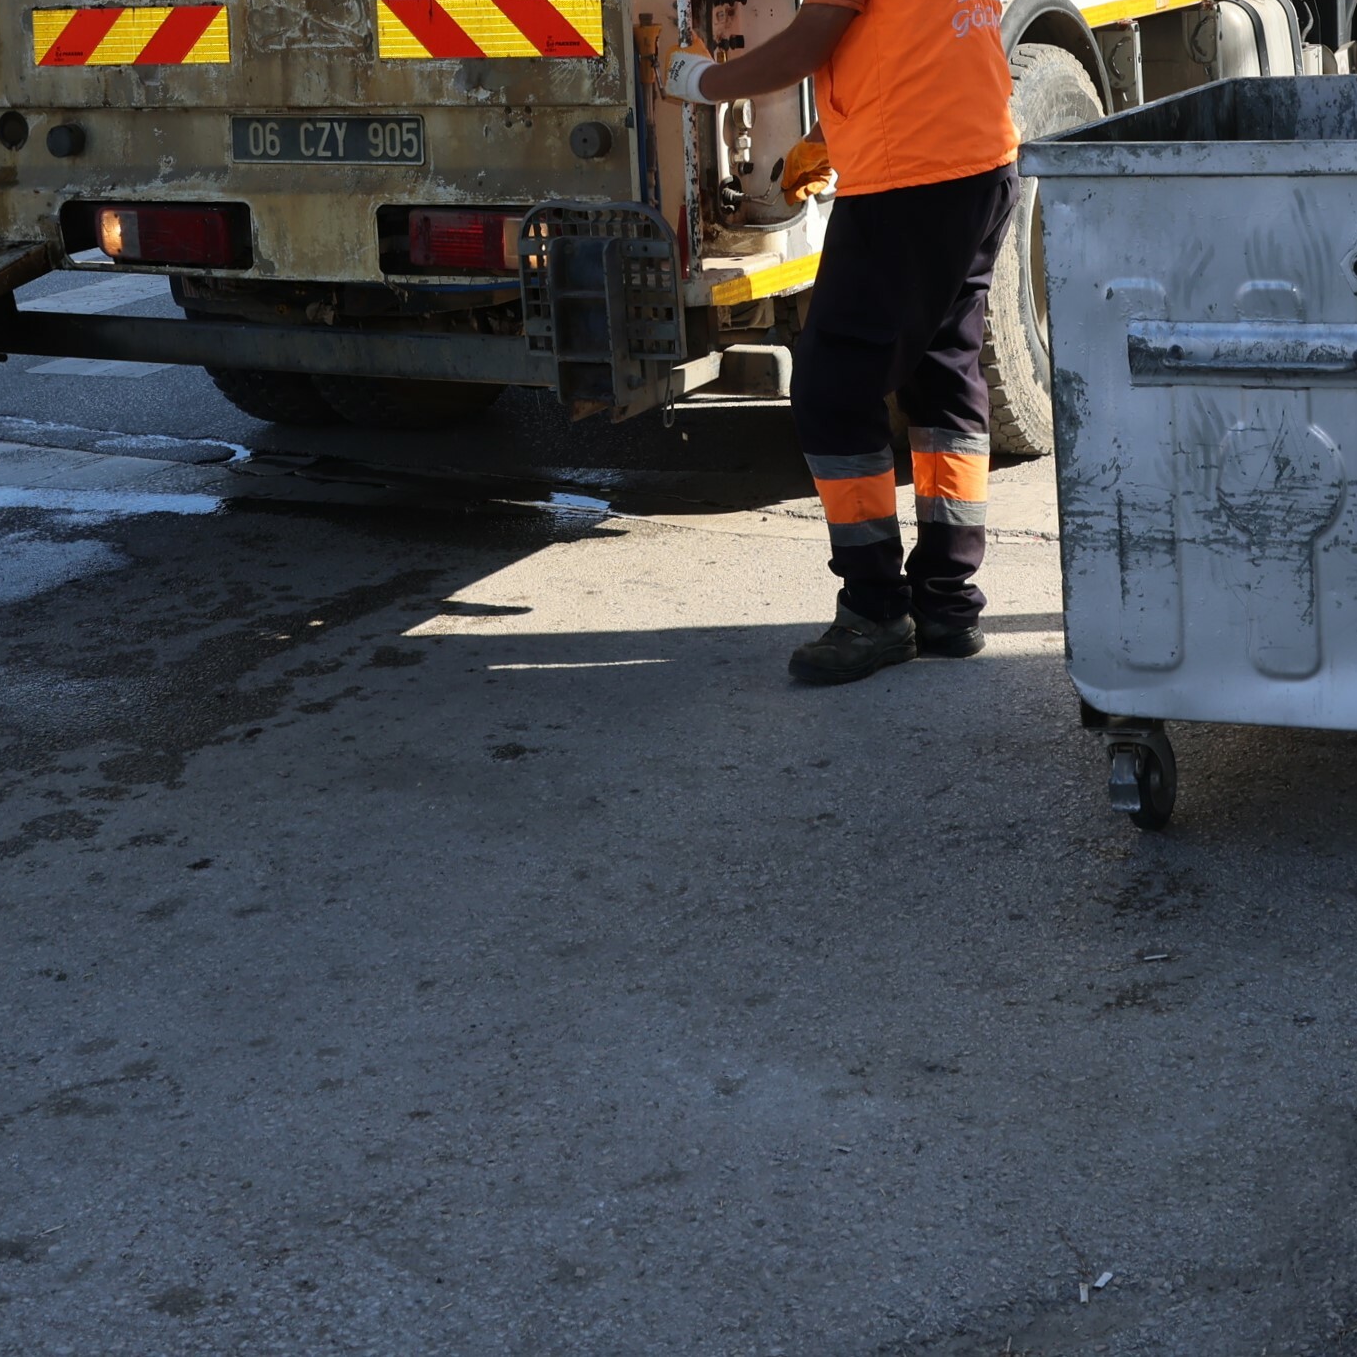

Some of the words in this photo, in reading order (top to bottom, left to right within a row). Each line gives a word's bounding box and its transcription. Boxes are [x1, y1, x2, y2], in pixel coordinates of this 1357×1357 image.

[248, 122, 280, 157] 06
[299, 122, 349, 157] CZY
[369, 122, 419, 158] 905
